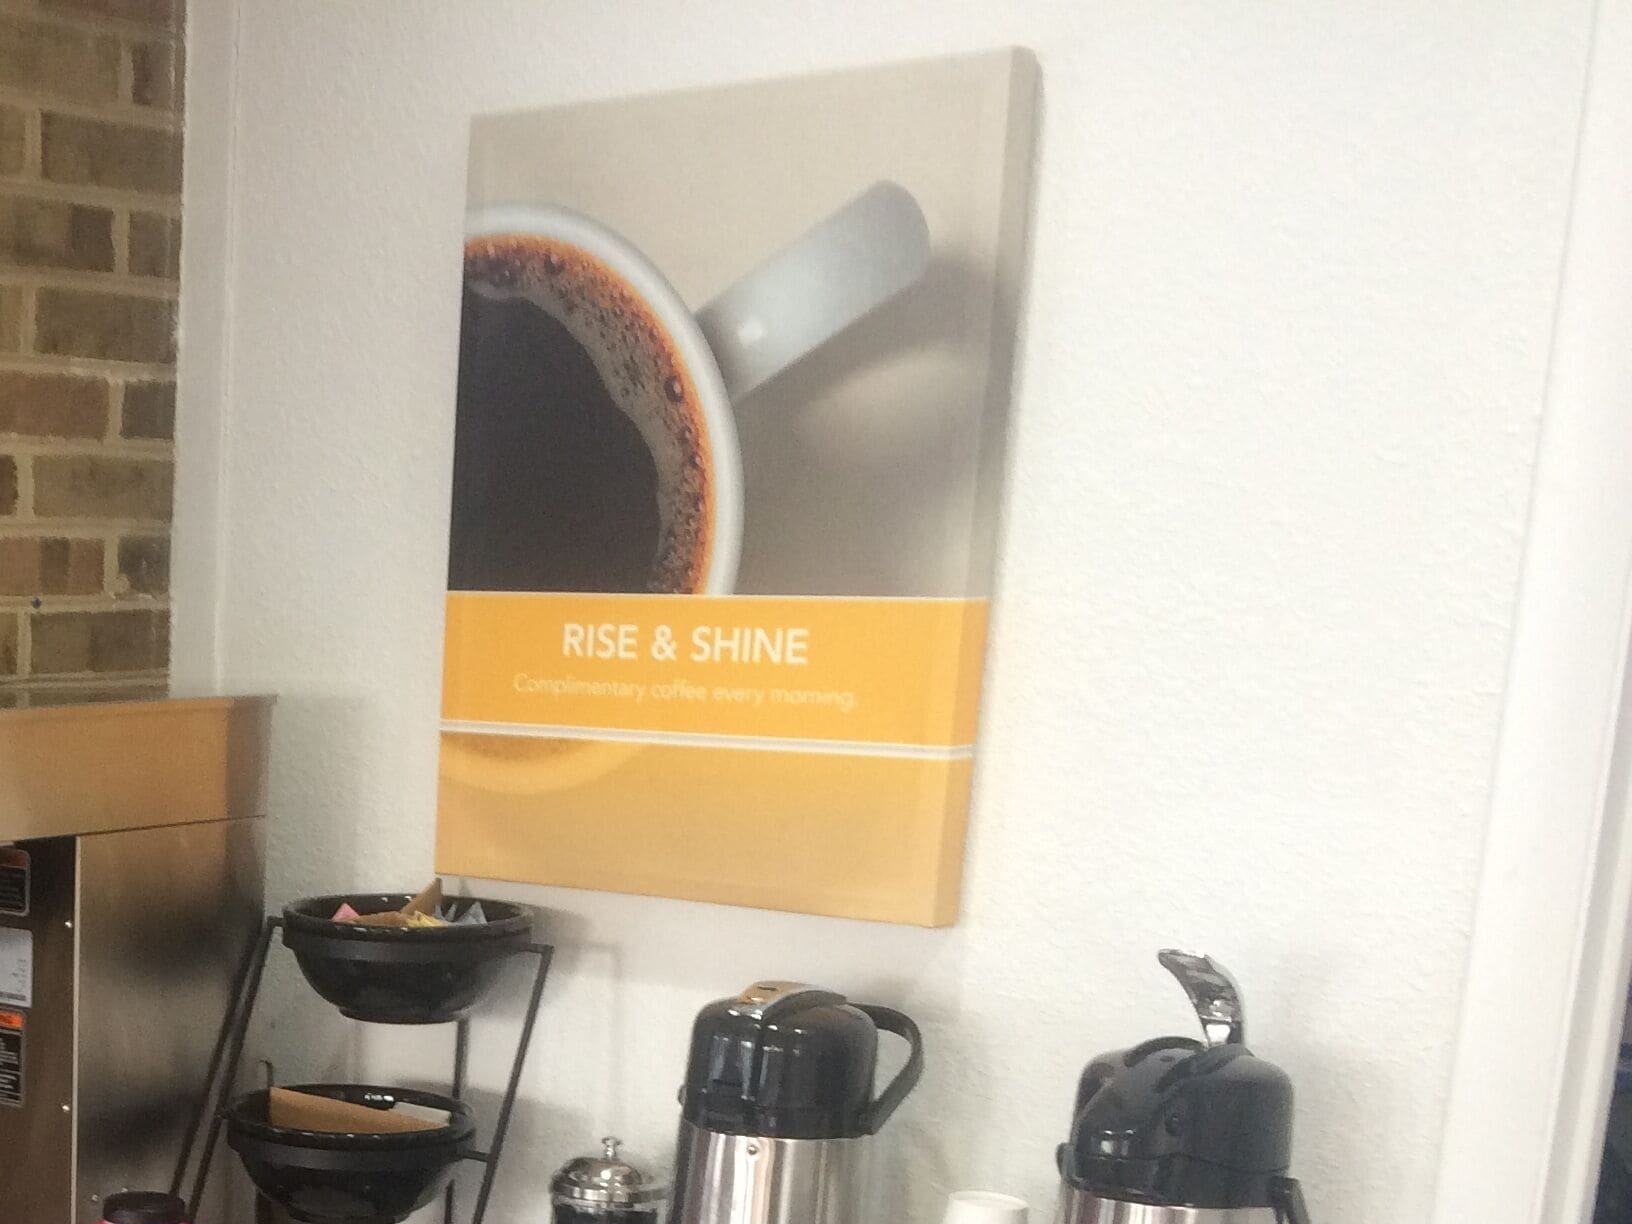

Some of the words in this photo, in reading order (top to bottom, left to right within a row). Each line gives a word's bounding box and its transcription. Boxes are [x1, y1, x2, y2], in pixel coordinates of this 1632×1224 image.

[562, 622, 639, 660] RISE
[650, 623, 678, 662] &
[689, 626, 809, 665] SHINE
